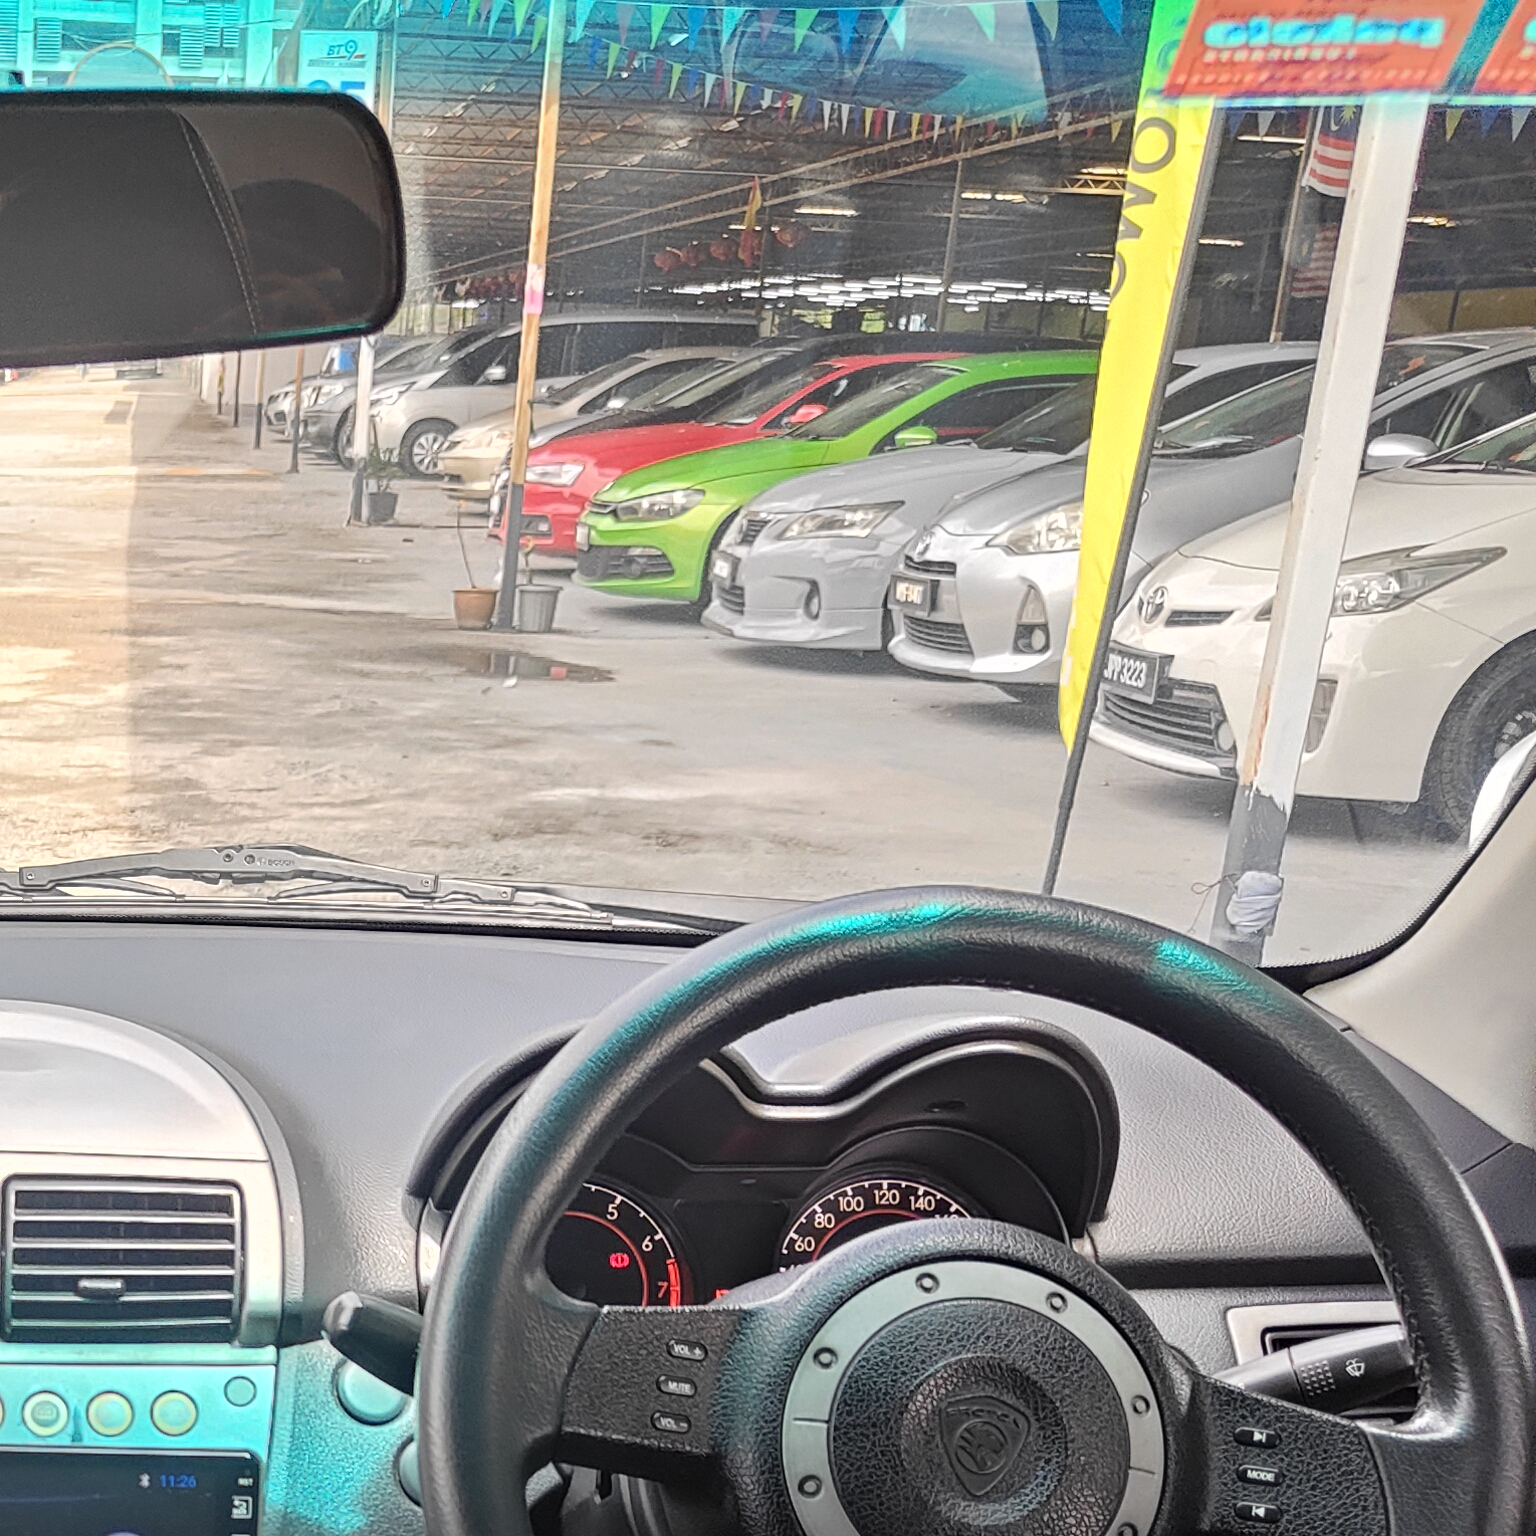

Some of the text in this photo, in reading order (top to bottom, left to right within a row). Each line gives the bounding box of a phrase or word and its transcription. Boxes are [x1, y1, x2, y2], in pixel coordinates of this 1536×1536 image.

[838, 1197, 864, 1212] 100
[874, 1190, 900, 1204] 120
[910, 1195, 935, 1211] 140
[606, 1204, 618, 1220] 5
[814, 1213, 835, 1228] 80
[641, 1236, 653, 1252] 6
[795, 1236, 815, 1252] 60
[658, 1282, 668, 1298] 7
[673, 1343, 690, 1356] VOL
[668, 1380, 691, 1393] MUTE
[660, 1417, 677, 1428] VOL
[160, 1475, 197, 1487] 11:26
[1247, 1470, 1275, 1483] MODE
